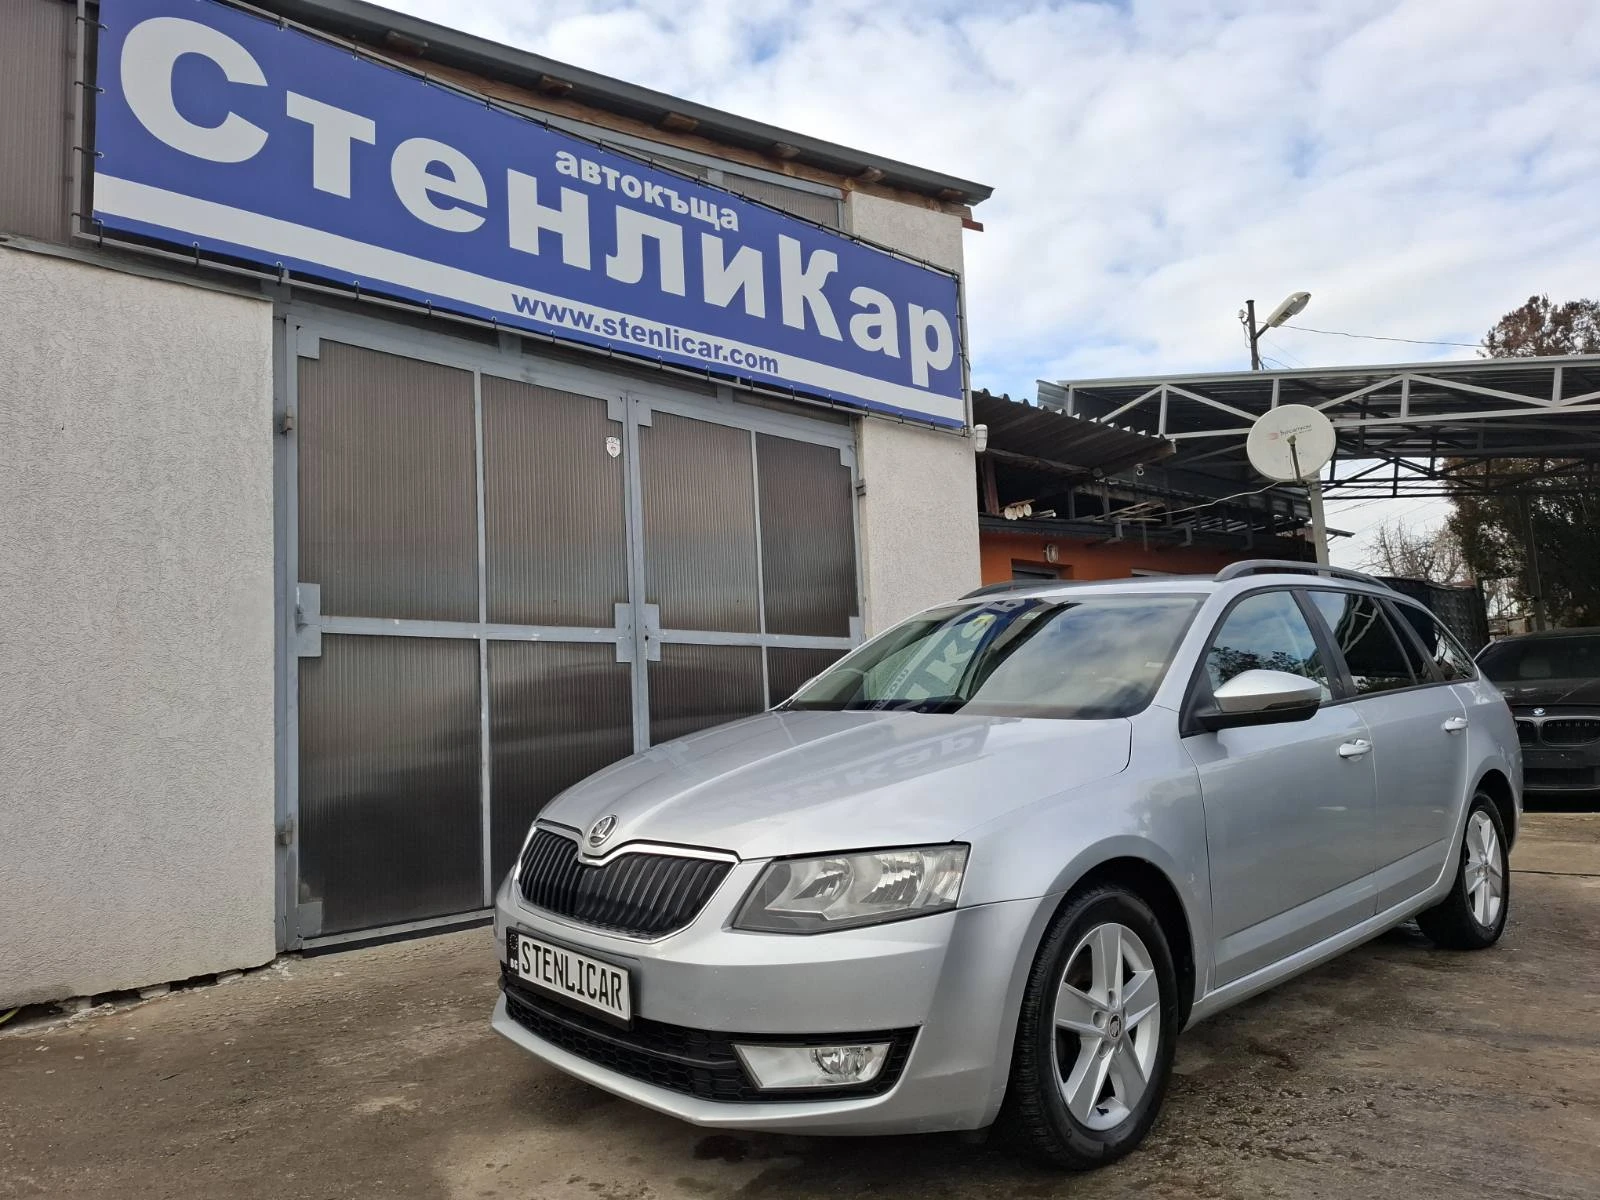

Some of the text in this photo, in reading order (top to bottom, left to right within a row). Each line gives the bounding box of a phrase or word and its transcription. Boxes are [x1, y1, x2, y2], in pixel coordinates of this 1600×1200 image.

[120, 16, 955, 388] СтенлиКар
[555, 150, 739, 232] автокъща
[511, 293, 779, 374] www.stenlicar.com
[521, 940, 623, 1011] STENLICAR
